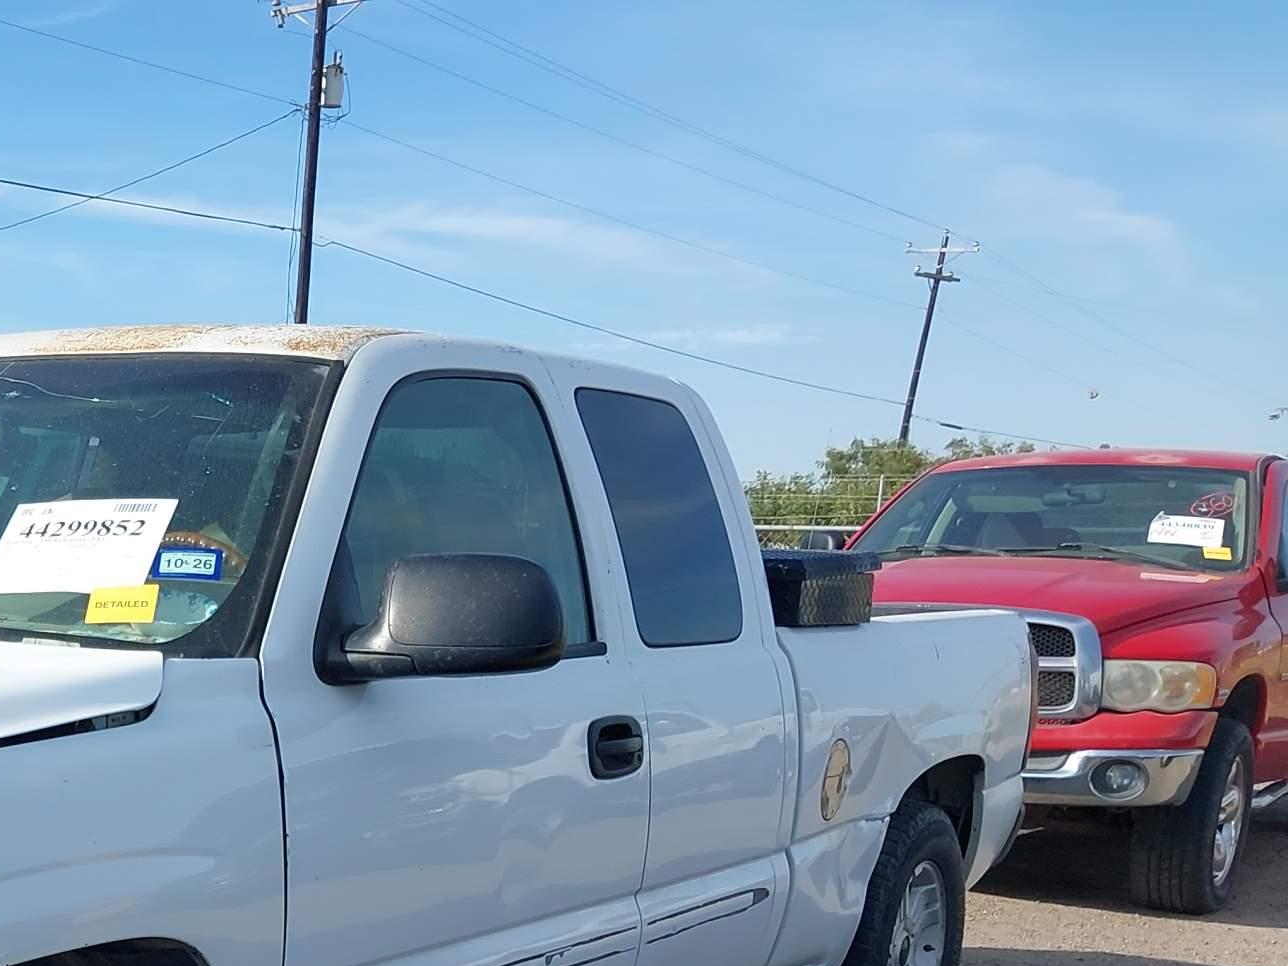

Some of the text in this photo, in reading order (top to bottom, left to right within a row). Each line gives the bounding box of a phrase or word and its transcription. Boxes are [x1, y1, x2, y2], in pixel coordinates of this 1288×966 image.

[19, 519, 146, 538] 44299852
[165, 558, 213, 569] 10 26
[95, 600, 149, 610] DETAILED
